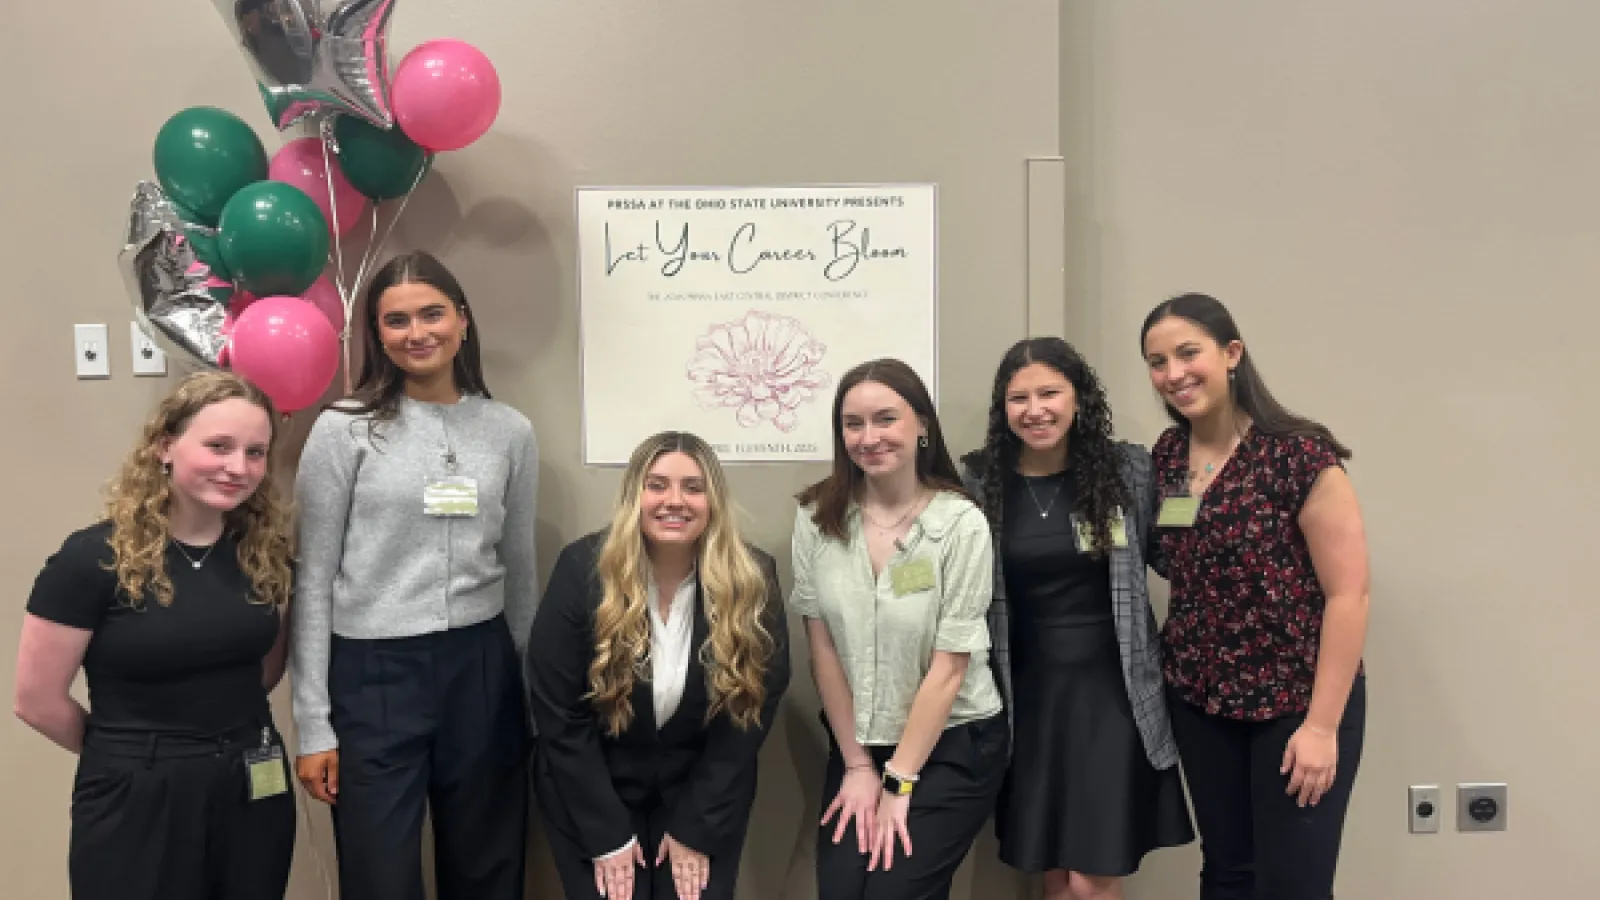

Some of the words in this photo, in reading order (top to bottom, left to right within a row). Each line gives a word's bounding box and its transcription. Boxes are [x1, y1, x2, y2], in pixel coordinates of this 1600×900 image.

[607, 199, 646, 209] PRSSA
[648, 199, 665, 209] AT
[668, 198, 691, 209] THE
[695, 198, 726, 209] OHIO
[730, 198, 767, 209] STATE
[770, 198, 840, 209] UNIVERSITY
[842, 196, 905, 207] PRESENTS
[604, 219, 650, 276] Let
[655, 219, 721, 277] Your
[727, 222, 816, 274] Career
[823, 219, 909, 281] Bloom
